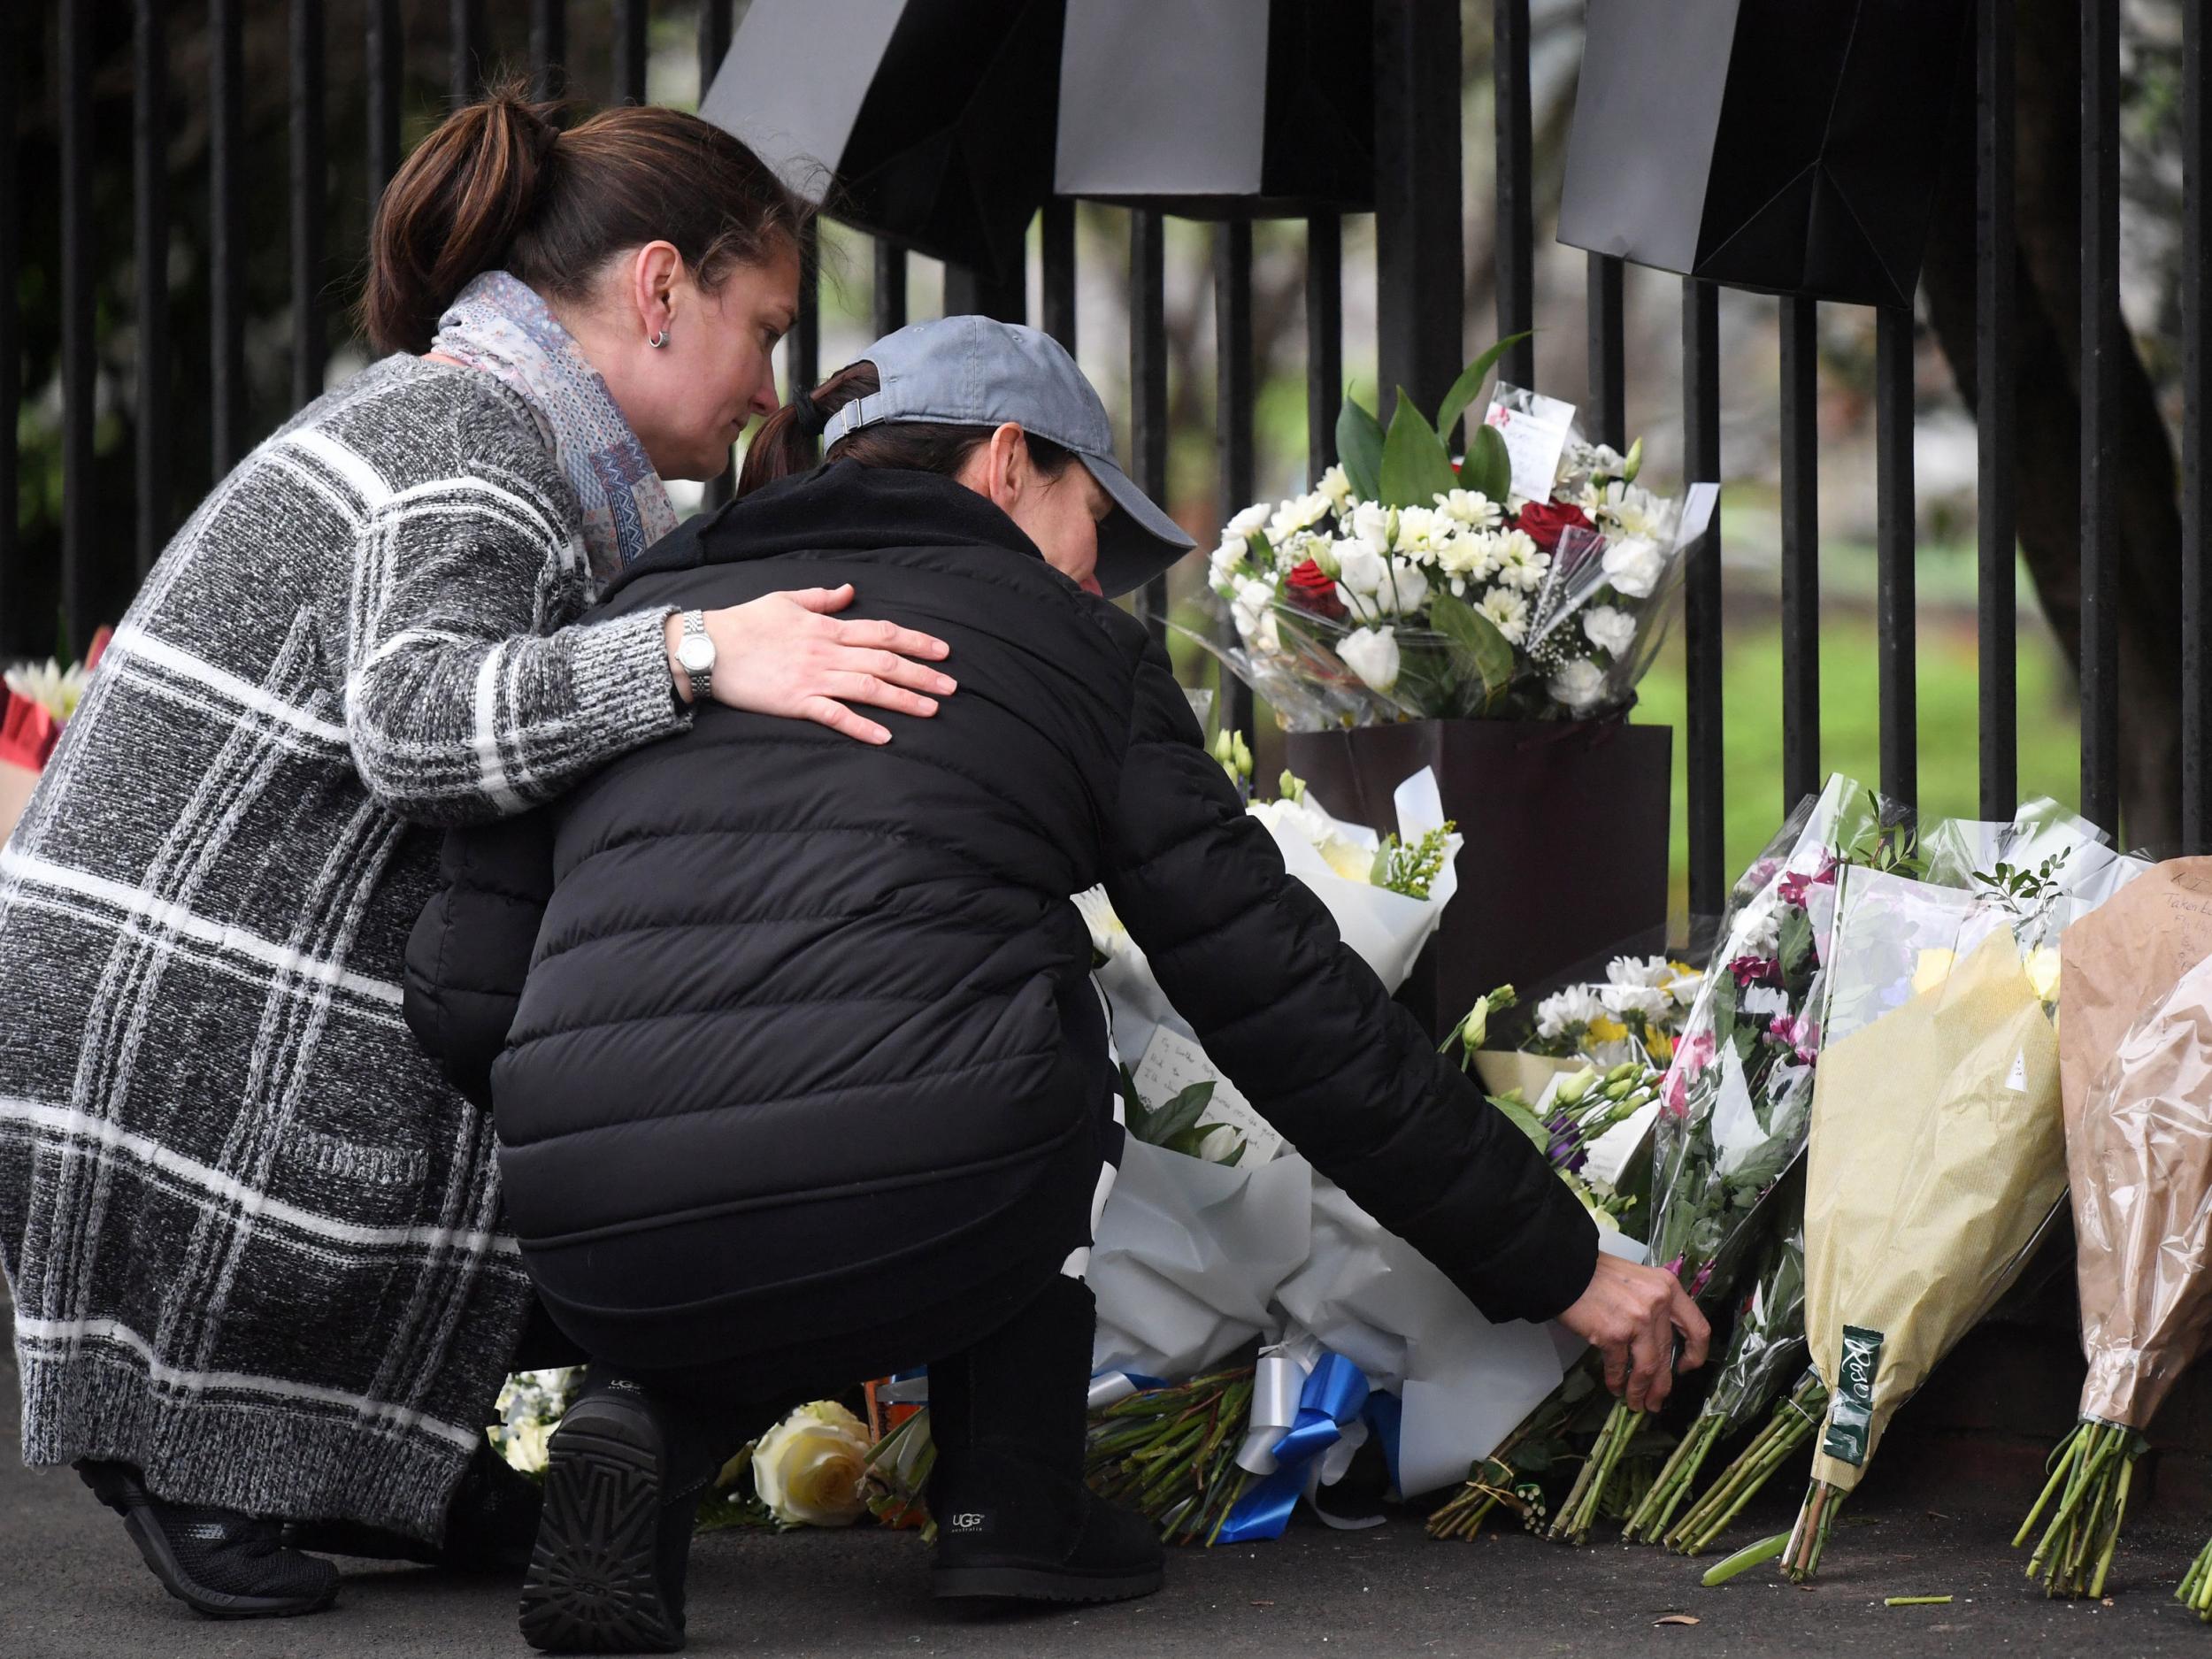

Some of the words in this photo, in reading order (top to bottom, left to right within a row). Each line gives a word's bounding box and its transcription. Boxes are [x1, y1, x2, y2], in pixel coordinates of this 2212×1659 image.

[2162, 893, 2198, 911] Taken
[1841, 1338, 1873, 1398] Rose
[953, 1513, 980, 1527] UGG
